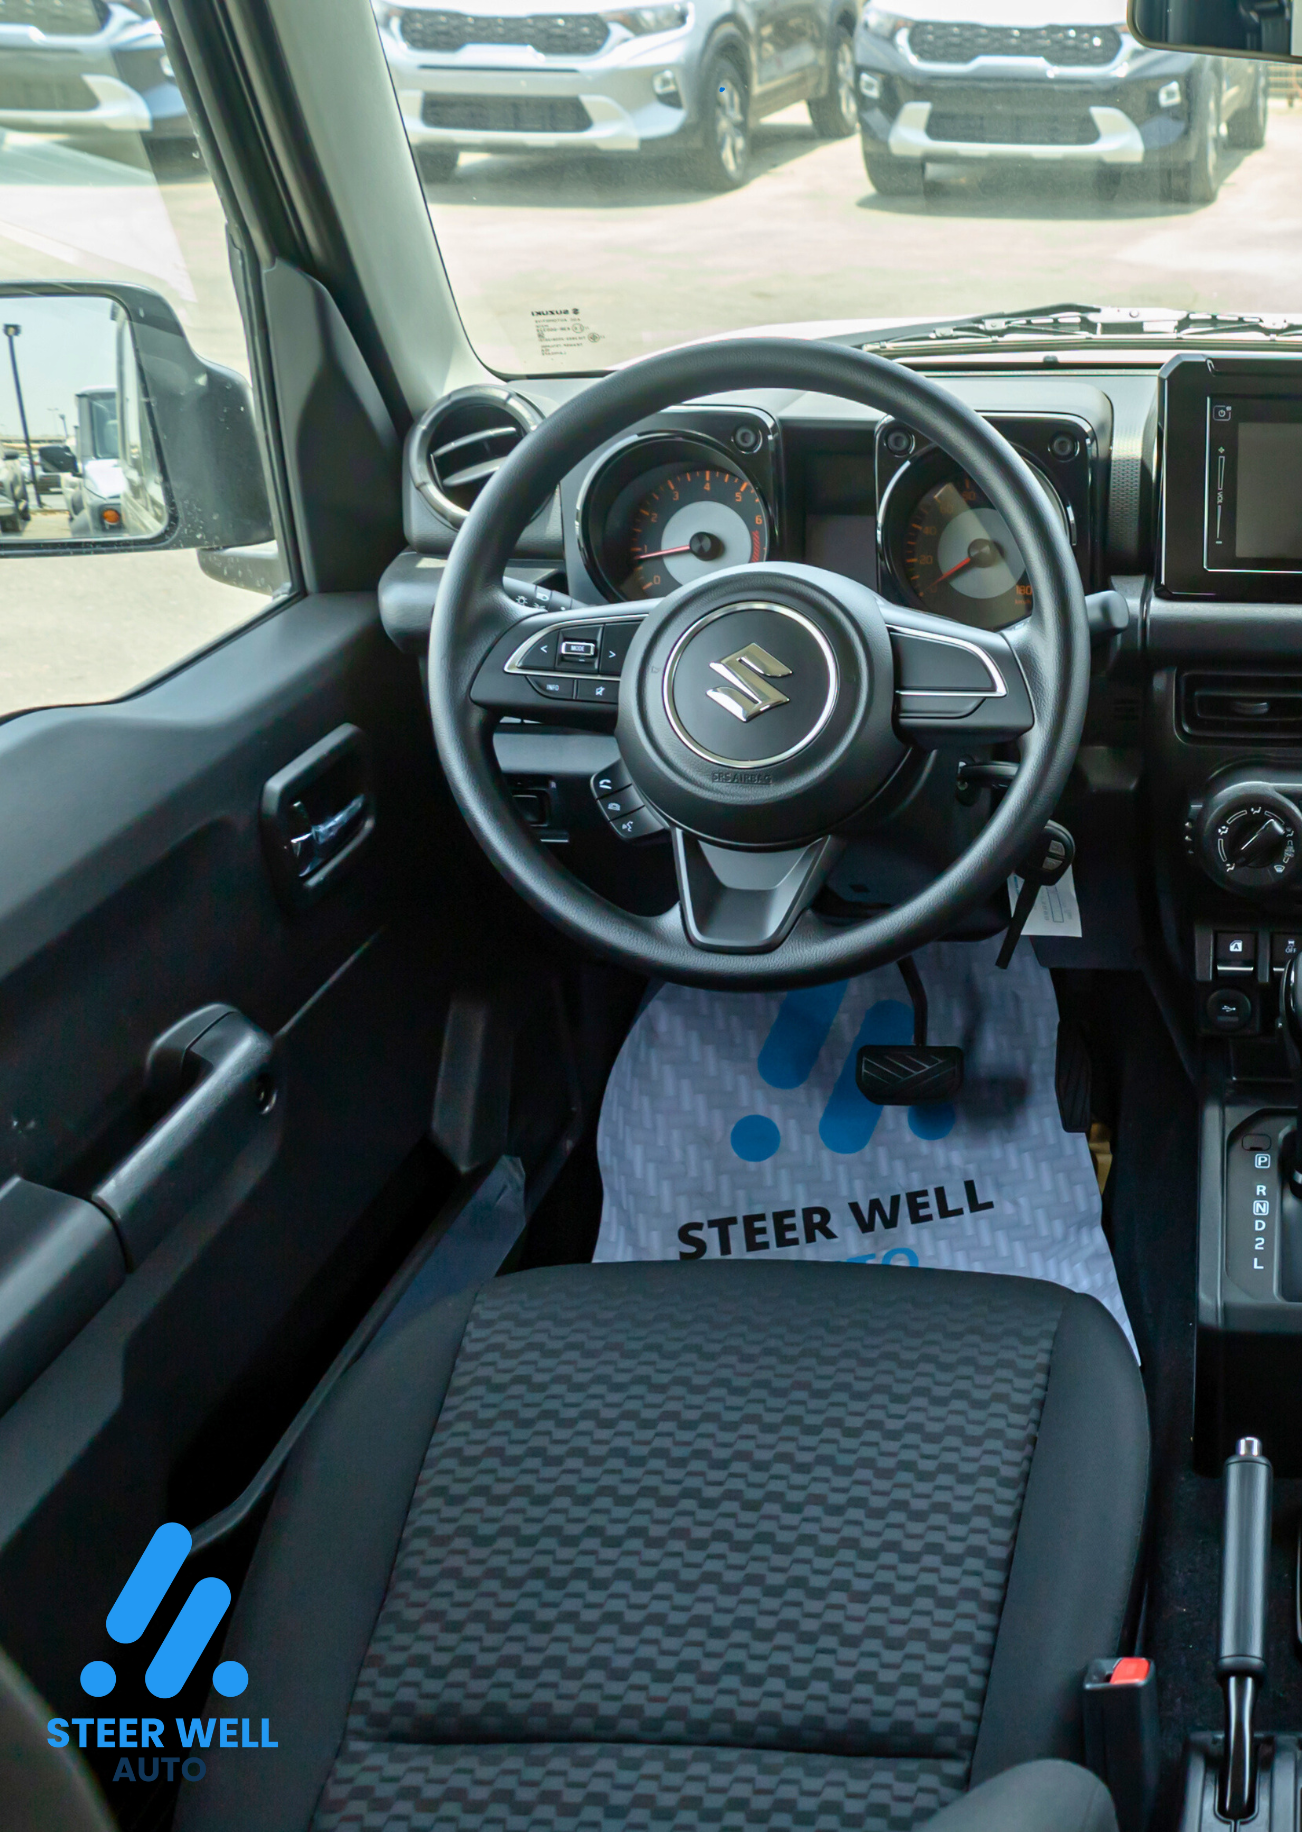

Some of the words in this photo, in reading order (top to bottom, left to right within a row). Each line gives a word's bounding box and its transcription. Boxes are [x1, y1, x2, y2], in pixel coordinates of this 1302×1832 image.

[703, 482, 711, 491] 4
[673, 491, 679, 501] 3
[735, 492, 742, 502] 5
[1216, 491, 1224, 505] VOL
[651, 513, 658, 522] 2
[755, 515, 763, 525] 6
[922, 526, 937, 536] 40
[920, 555, 933, 565] 20
[653, 575, 661, 585] 0
[1016, 584, 1033, 596] 180
[1285, 946, 1297, 954] OFF
[1257, 1156, 1268, 1166] P
[1256, 1184, 1267, 1196] R
[1255, 1202, 1266, 1213] N
[677, 1206, 838, 1260] STEER
[847, 1179, 994, 1234] WELL
[1254, 1219, 1266, 1231] D
[1254, 1237, 1265, 1250] 2
[1253, 1257, 1264, 1269] L
